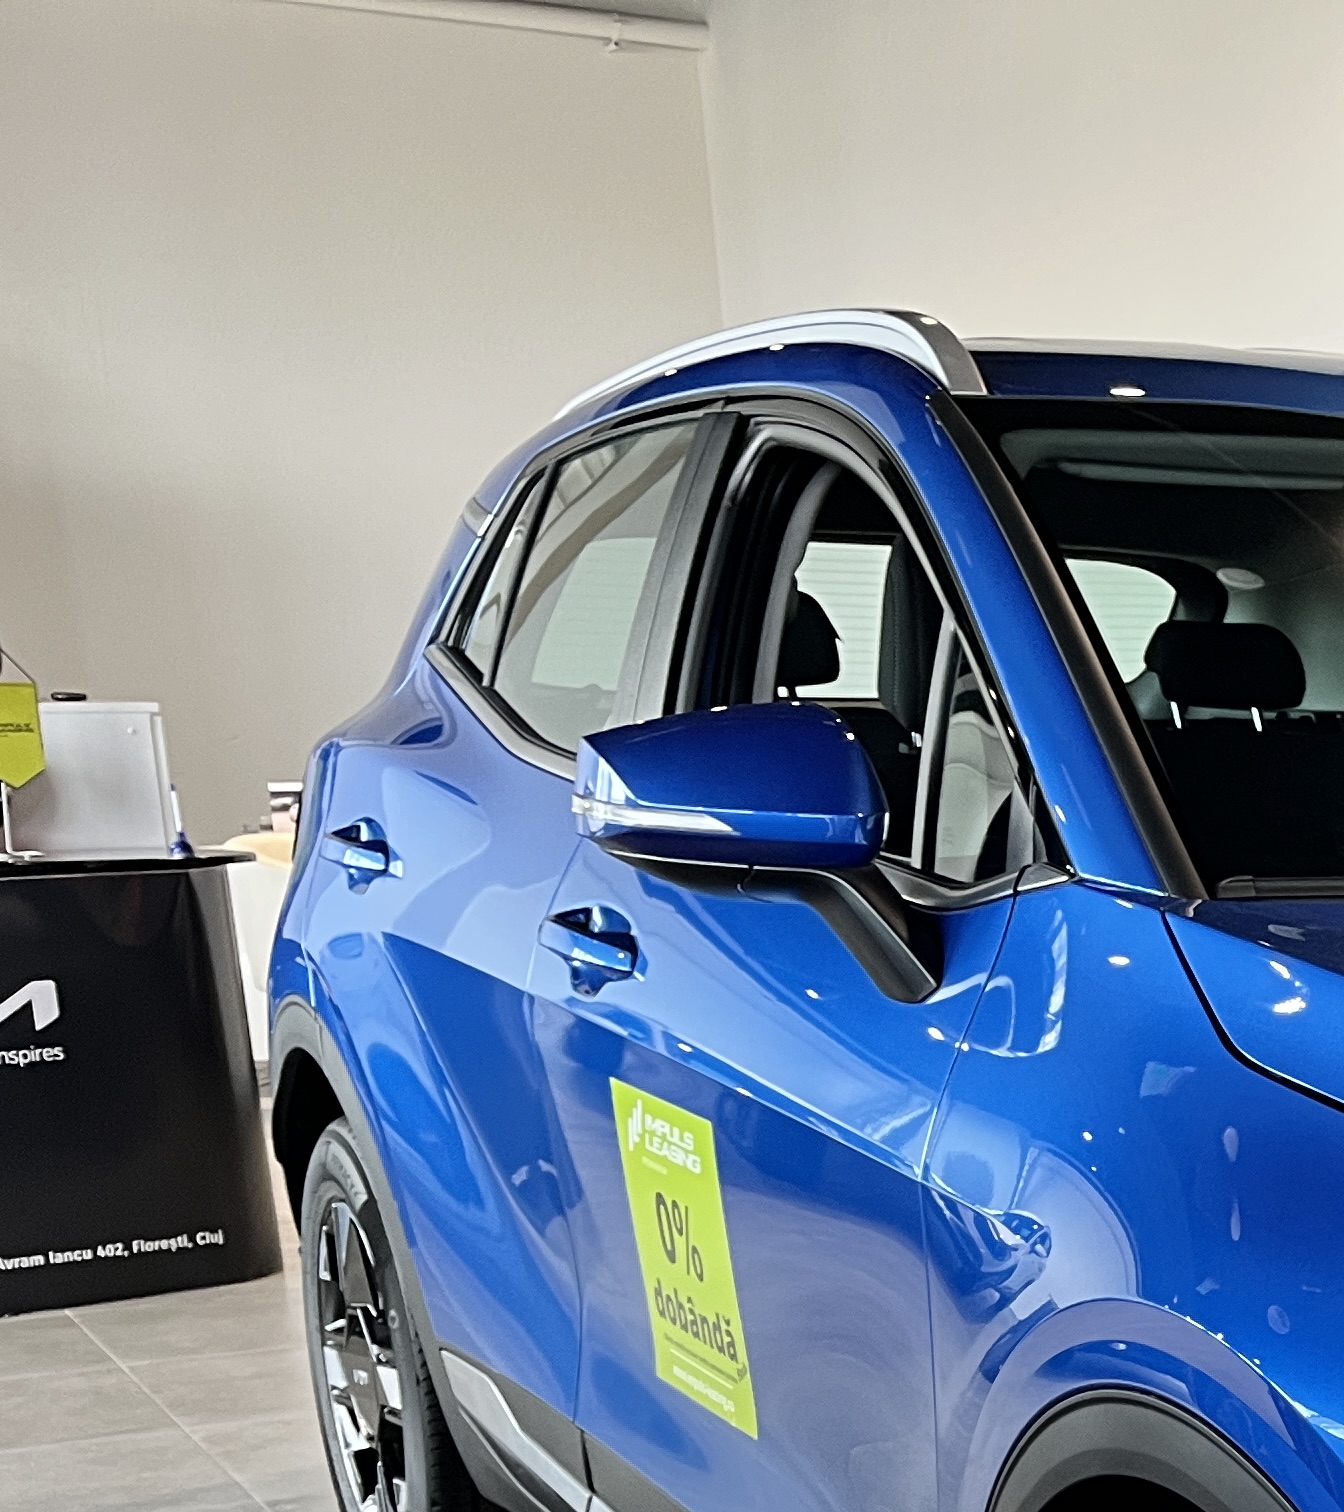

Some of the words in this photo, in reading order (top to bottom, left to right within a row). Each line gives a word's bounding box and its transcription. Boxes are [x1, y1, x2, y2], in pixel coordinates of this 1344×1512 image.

[0, 1044, 66, 1068] nspires
[48, 1248, 94, 1265] Iancu
[96, 1241, 130, 1258] 402,
[195, 1228, 224, 1246] Cluj
[655, 1191, 704, 1283] 0%
[654, 1277, 739, 1365] dobândă
